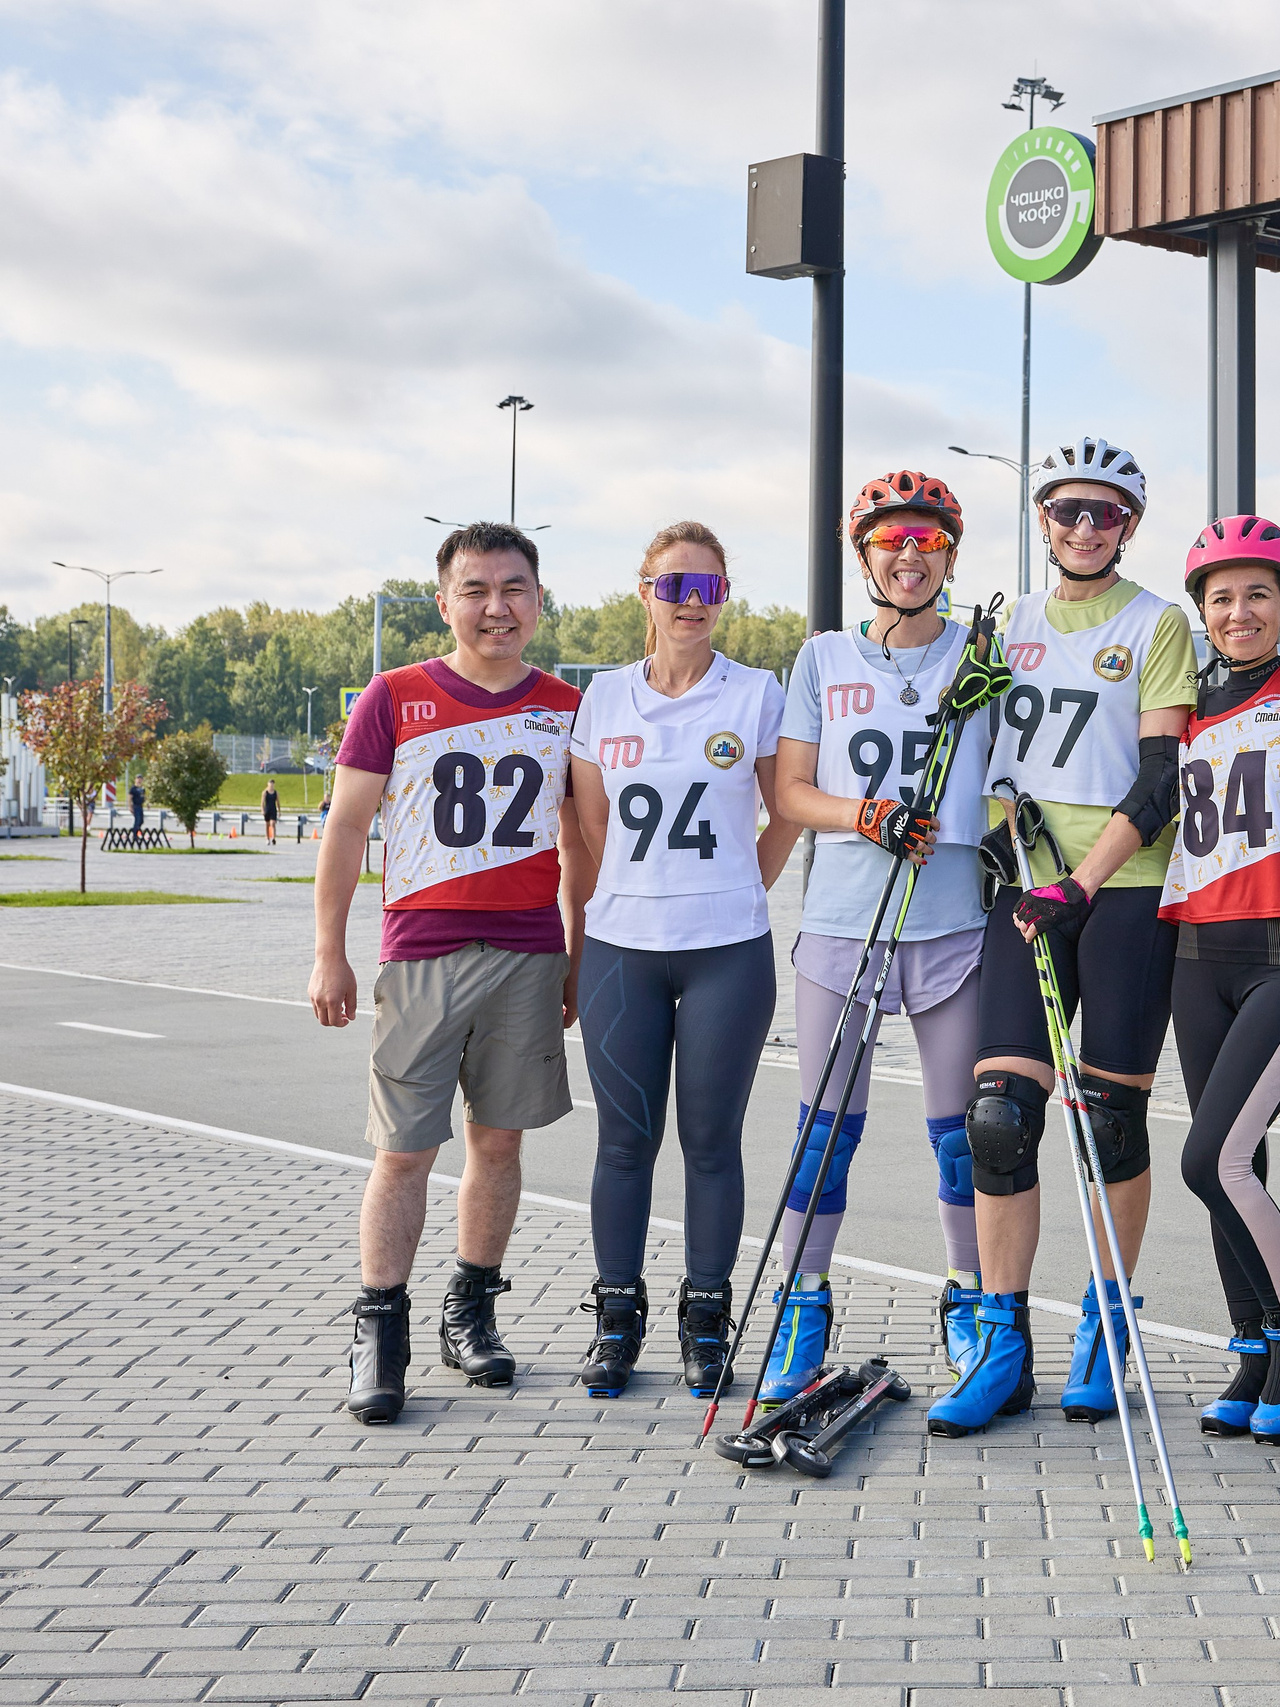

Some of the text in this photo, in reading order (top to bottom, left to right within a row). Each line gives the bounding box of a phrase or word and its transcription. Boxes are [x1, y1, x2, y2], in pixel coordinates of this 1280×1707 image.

[1010, 186, 1064, 206] чашка
[1018, 201, 1061, 224] кофе
[1249, 661, 1280, 680] CRAFT
[1004, 684, 1099, 768] 97
[848, 729, 949, 809] 95
[433, 752, 544, 849] 82
[618, 782, 718, 862] 94
[1182, 750, 1273, 857] 84
[598, 1286, 636, 1294] SPINE
[686, 1291, 724, 1299] SPINE
